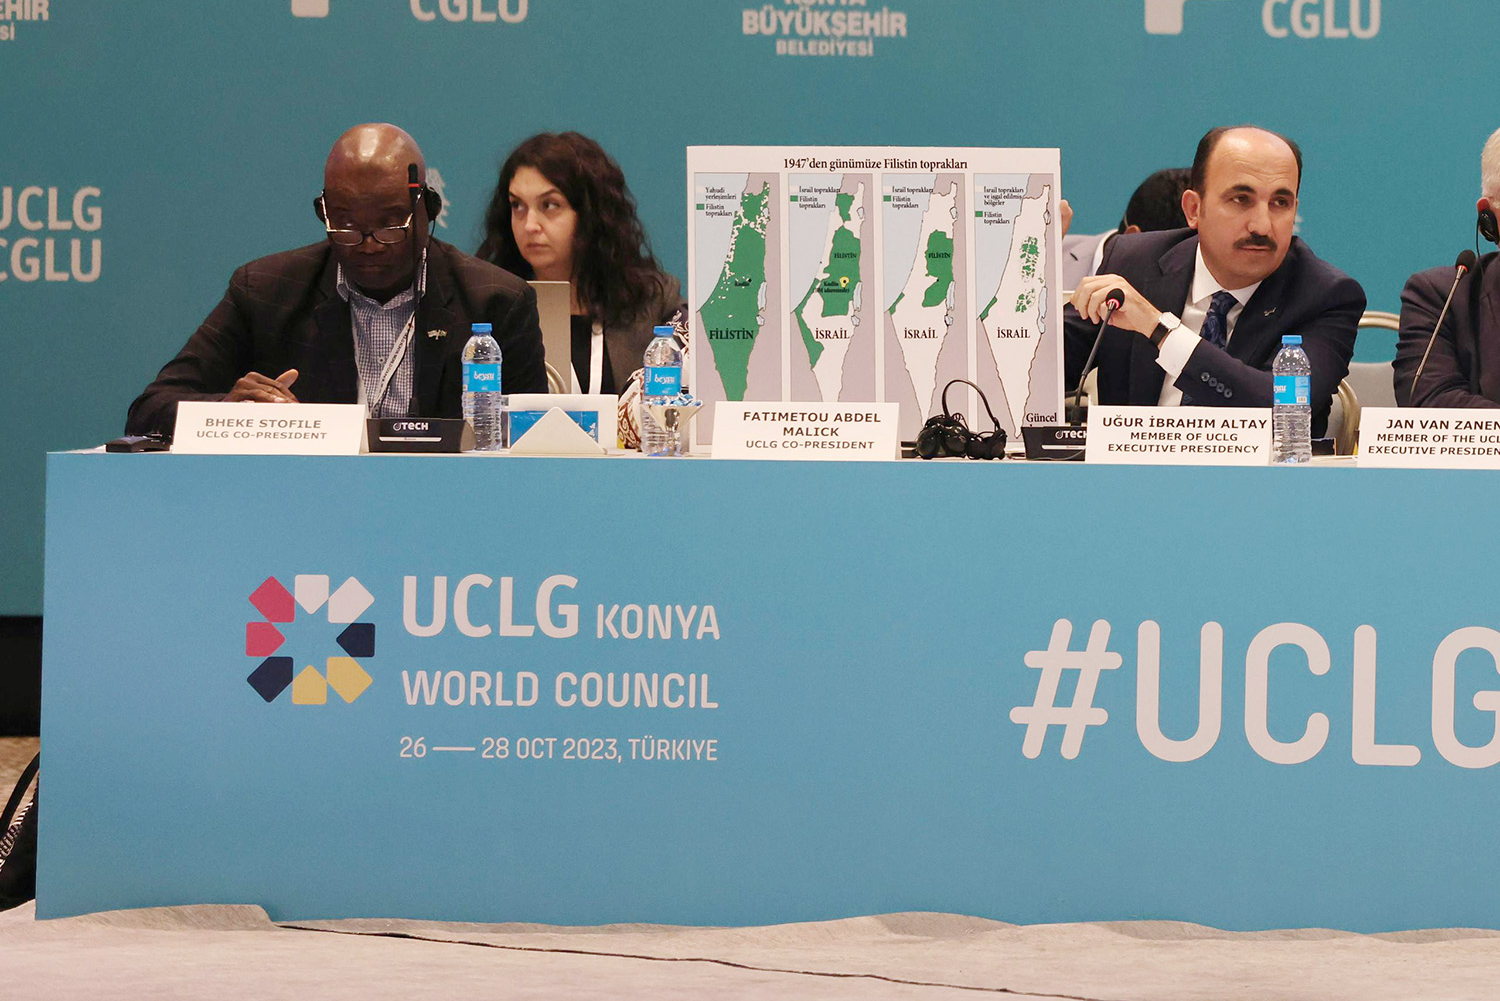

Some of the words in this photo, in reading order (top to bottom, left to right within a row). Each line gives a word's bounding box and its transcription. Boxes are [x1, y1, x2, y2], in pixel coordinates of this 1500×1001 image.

[742, 5, 907, 40] BÜYÜKŞEHİR
[775, 36, 874, 57] BELEDİYESİ
[783, 158, 828, 170] 1947'den
[829, 158, 882, 172] günümüze
[884, 158, 918, 170] Filistin
[920, 158, 968, 172] toprakları
[709, 327, 754, 340] FİLİSTİN
[815, 327, 850, 339] İSRAİL
[904, 327, 938, 339] İSRAİL
[997, 329, 1031, 339] İSRAİL
[743, 411, 829, 422] FATIMETOU
[833, 412, 882, 423] ABDEL
[1026, 412, 1057, 422] Güncel
[1102, 414, 1144, 428] UĞUR
[1220, 419, 1268, 429] ALTAY
[205, 418, 255, 428] BHEKE
[259, 419, 322, 429] STOFILE
[1386, 419, 1415, 429] JAN
[1419, 419, 1450, 430] VAN
[196, 430, 230, 440] UCLG
[233, 431, 328, 440] CO-PRESIDENT
[783, 427, 840, 437] MALICK
[1130, 432, 1182, 441] MEMBER
[1186, 432, 1202, 441] OF
[1205, 433, 1238, 442] UCLG
[1376, 433, 1428, 443] MEMBER
[1432, 434, 1449, 443] OF
[1452, 434, 1476, 443] THE
[746, 440, 778, 449] UCLG
[781, 440, 875, 450] CO-PRESIDENT
[1107, 444, 1176, 453] EXECUTIVE
[1180, 444, 1259, 454] PRESIDENCY
[1368, 445, 1437, 455] EXECUTIVE
[402, 573, 580, 639] UCLG
[596, 603, 721, 641] KONYA
[401, 669, 540, 707] WORLD
[553, 671, 720, 709] COUNCIL
[399, 736, 427, 759] 26
[481, 737, 510, 759] 28
[516, 737, 558, 759] OCT
[563, 738, 622, 763] 2023,
